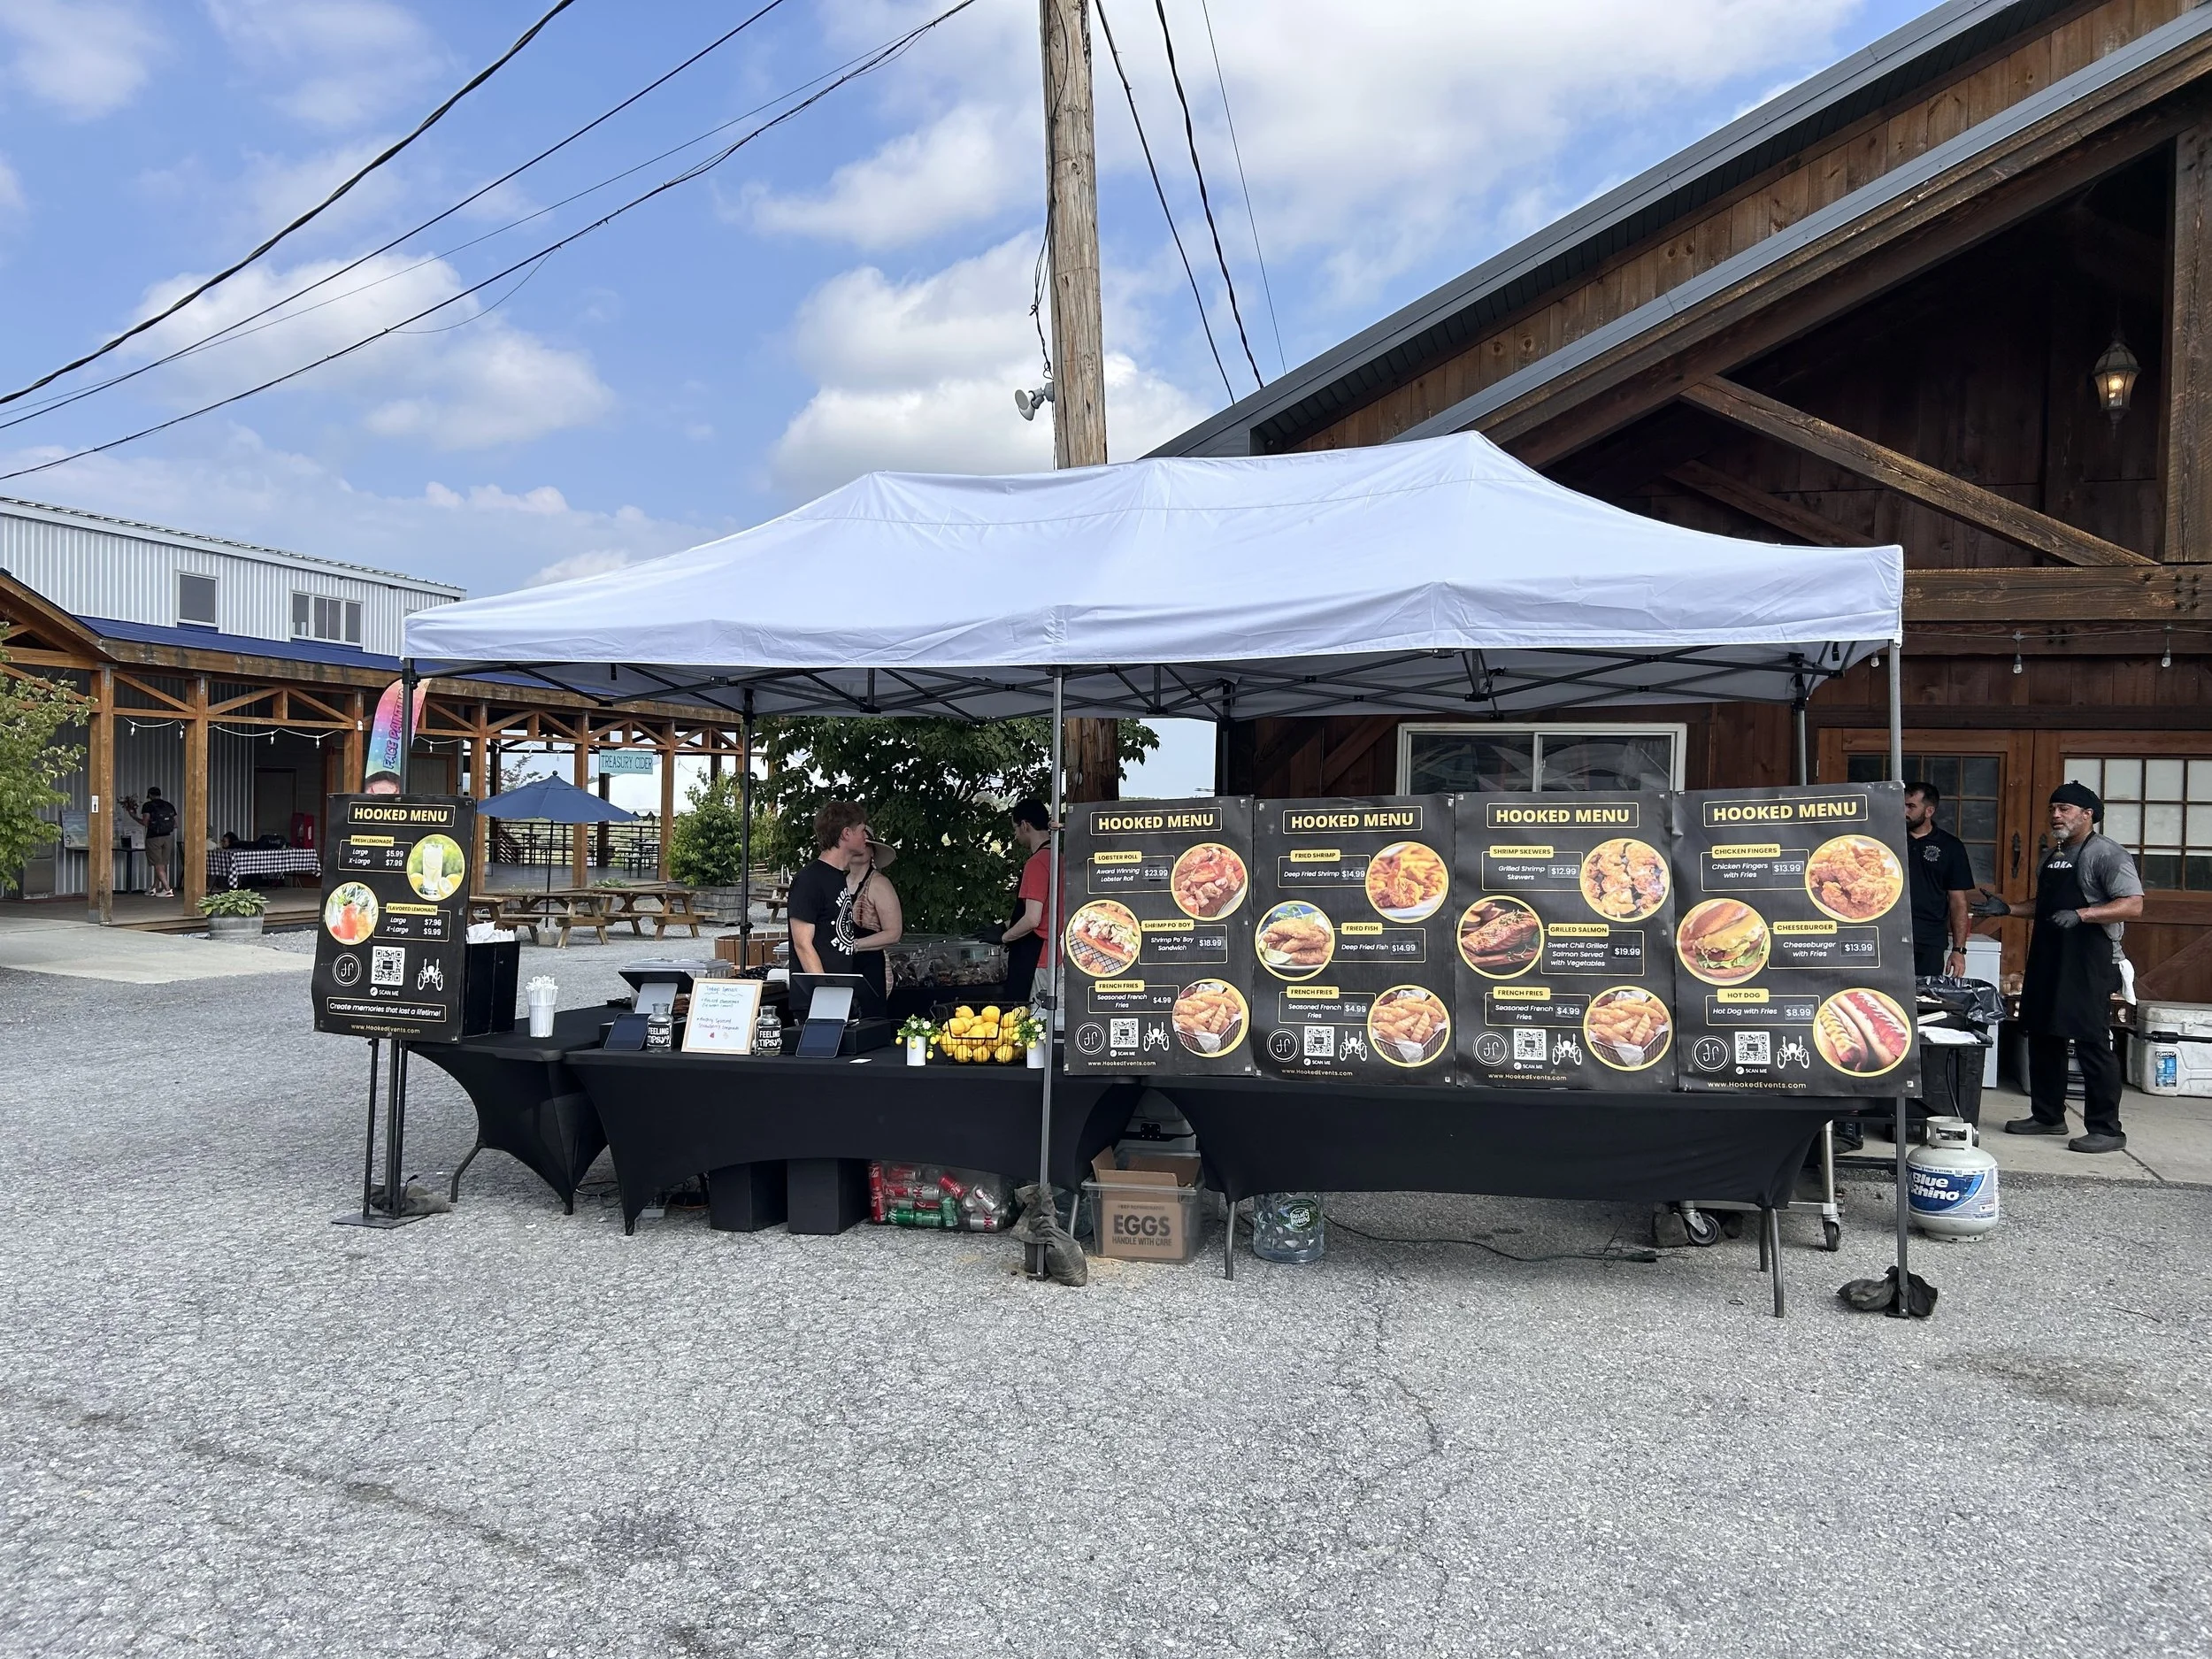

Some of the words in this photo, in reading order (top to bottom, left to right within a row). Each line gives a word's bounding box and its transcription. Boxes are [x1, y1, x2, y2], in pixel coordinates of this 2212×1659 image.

[383, 740, 398, 769] FACE
[602, 755, 632, 768] TREASURY
[635, 757, 653, 769] CIDER
[354, 808, 407, 821] HOOKED
[410, 810, 447, 822] MENU
[1496, 810, 1570, 823] HOOKED
[1576, 809, 1629, 823] MENU
[1714, 805, 1793, 821] HOOKED
[1799, 802, 1856, 818] MENU
[1098, 816, 1163, 830] HOOKED
[1168, 814, 1213, 827] MENU
[1291, 815, 1359, 828] HOOKED
[1364, 813, 1413, 827] MENU
[1774, 864, 1801, 872] $13.99
[353, 1005, 384, 1013] memories
[416, 1008, 441, 1016] lifetime!
[1557, 1007, 1579, 1015] $4.99
[1913, 1172, 1948, 1187] Blue
[1911, 1184, 1959, 1201] Rhino
[1114, 1214, 1170, 1236] EGGS
[1112, 1236, 1137, 1245] HANDLE
[1138, 1237, 1154, 1246] WITH
